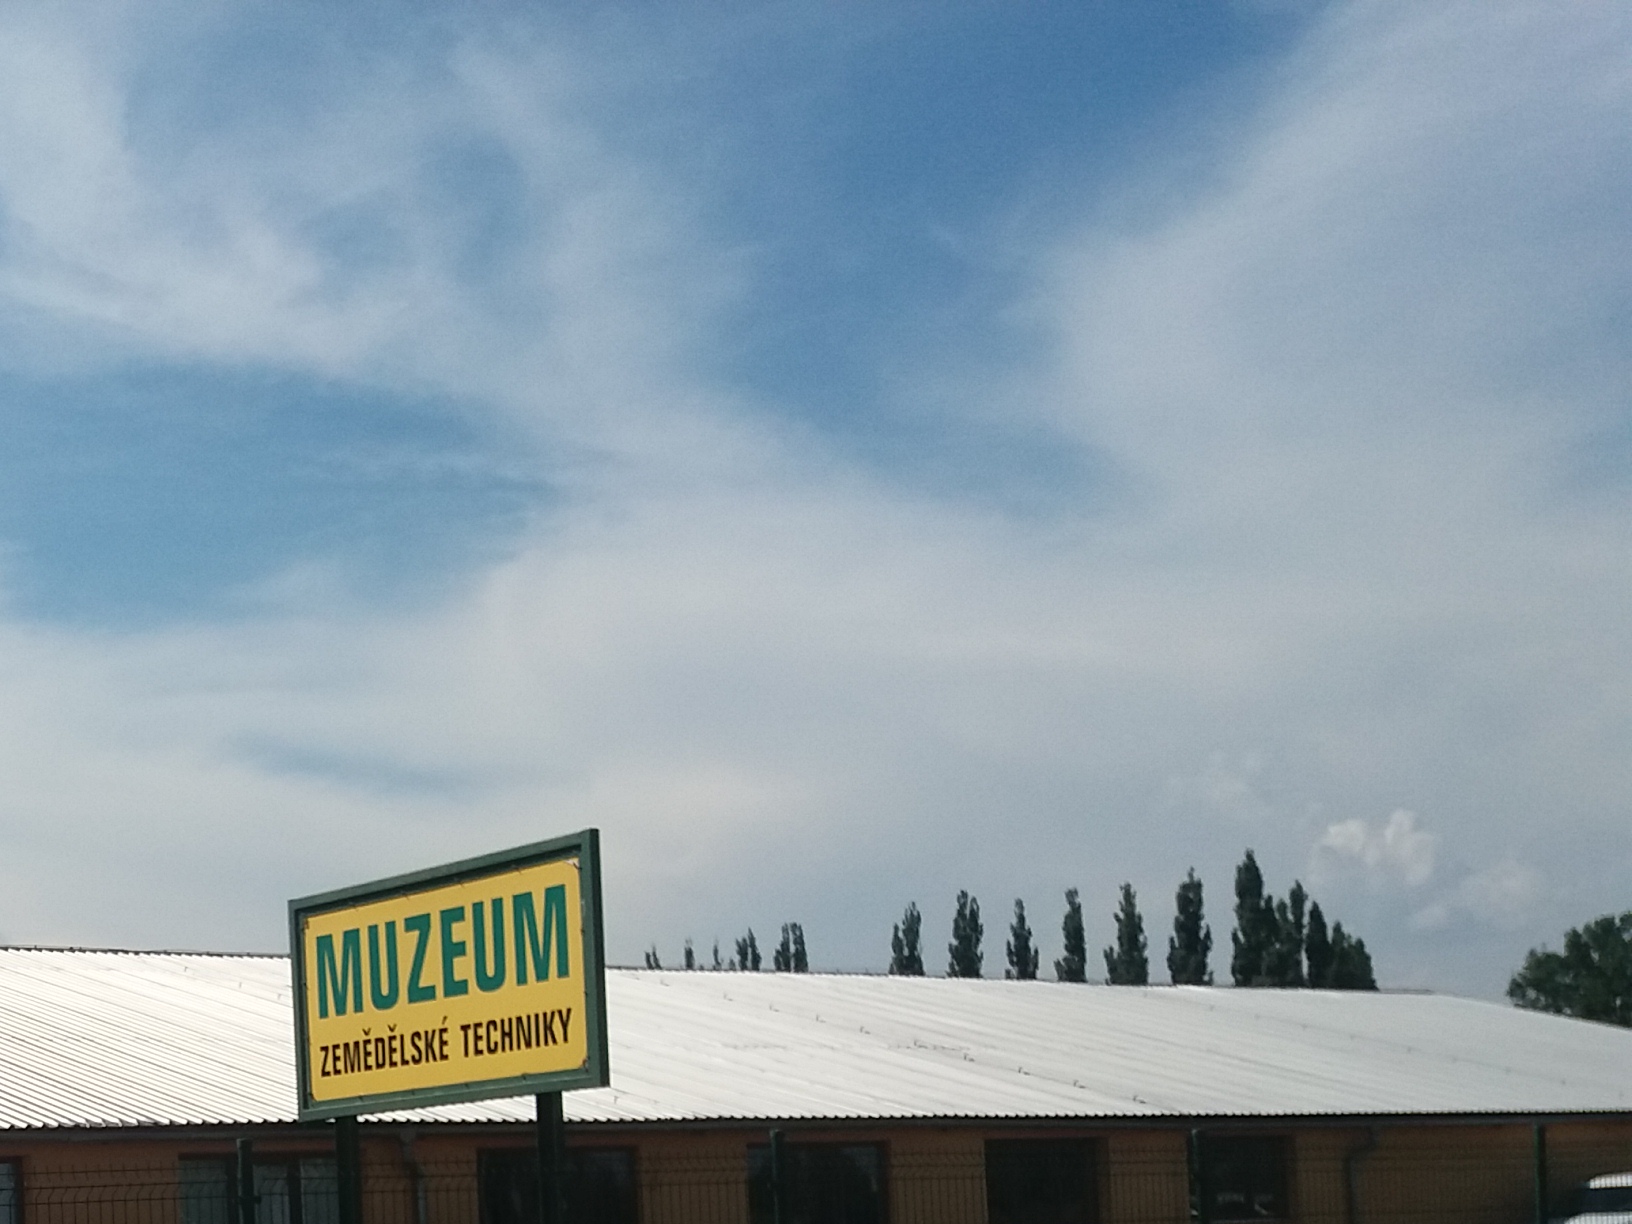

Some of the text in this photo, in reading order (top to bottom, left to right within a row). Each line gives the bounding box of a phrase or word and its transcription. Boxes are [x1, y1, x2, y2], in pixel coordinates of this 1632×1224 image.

[316, 883, 570, 1019] MUZEUM
[320, 1007, 573, 1078] ZEMĚDĚLSKÉ TECHNIKY
